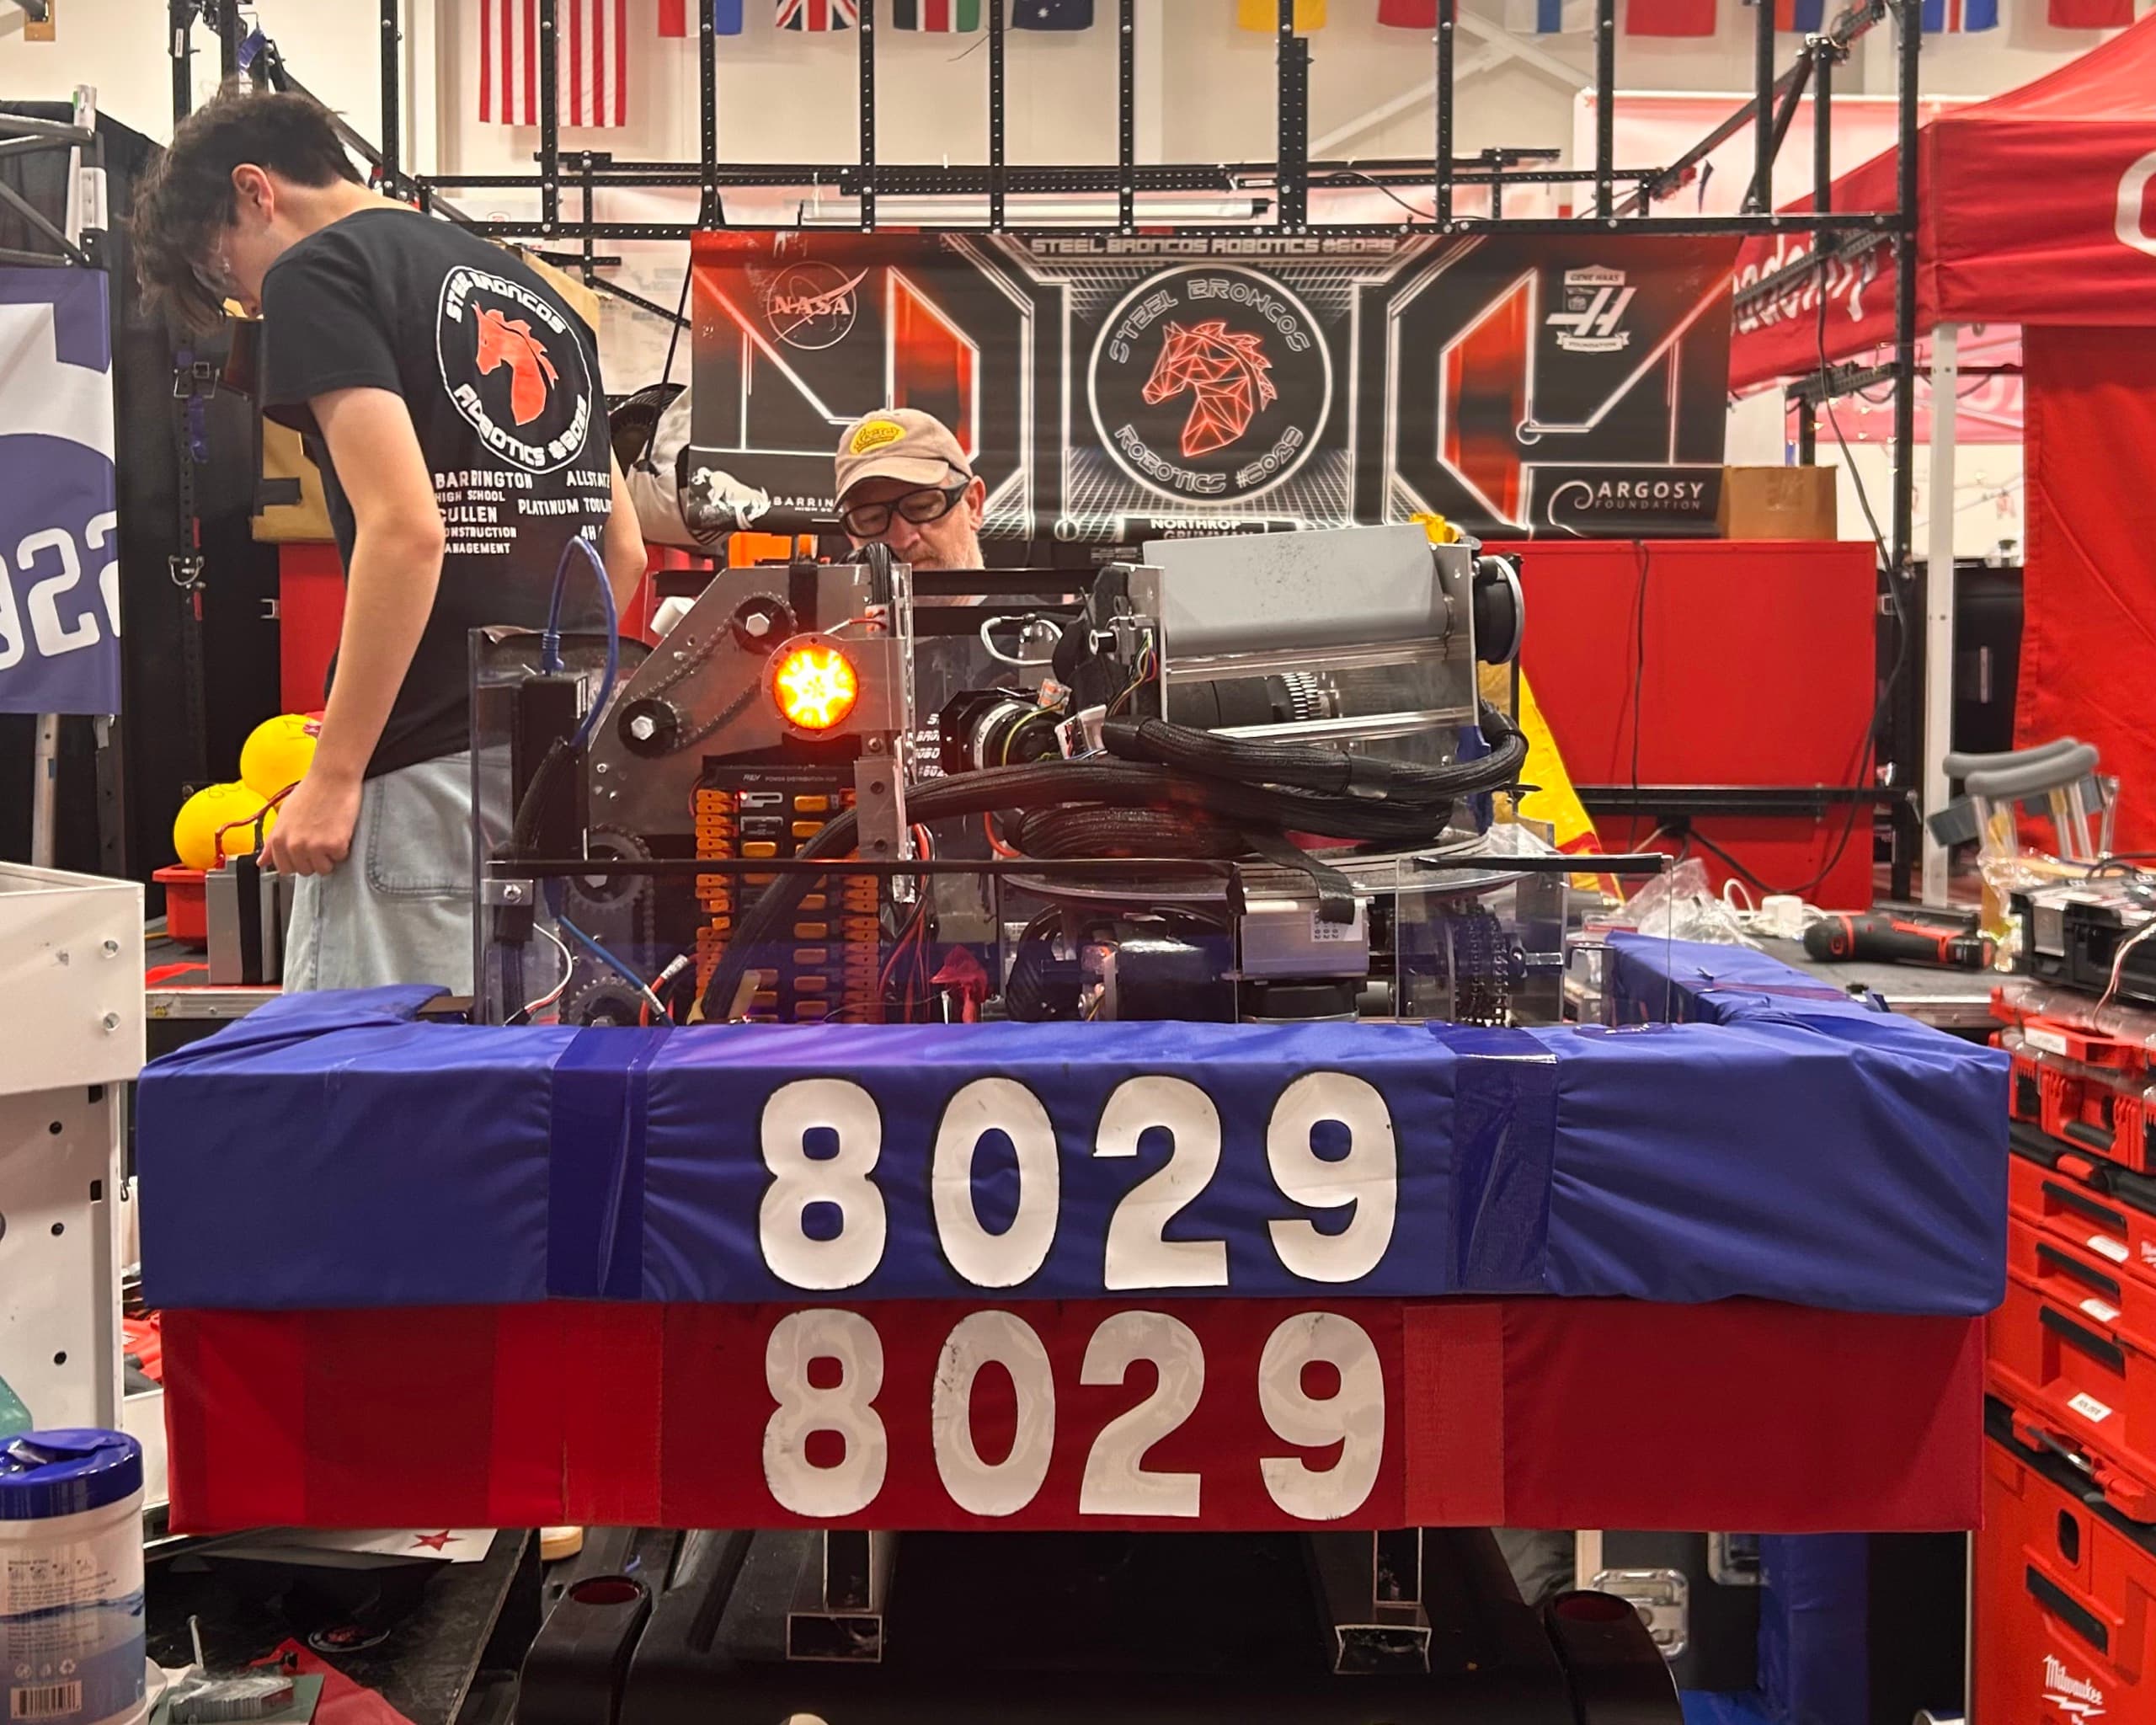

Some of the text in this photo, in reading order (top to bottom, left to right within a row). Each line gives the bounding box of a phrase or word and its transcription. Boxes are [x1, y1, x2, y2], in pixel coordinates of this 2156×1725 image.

[1031, 238, 1106, 254] STEEL
[1107, 238, 1208, 254] BRONCOS
[1211, 238, 1319, 254] ROBOTICS
[772, 296, 851, 316] NASA
[1108, 278, 1310, 364] STEEL BRONCOS
[453, 383, 546, 467] ROBOTICS
[1114, 424, 1305, 494] ROBOTICS #8029
[434, 469, 533, 489] BARRINGTON
[467, 489, 506, 503] SCHOOL
[1597, 481, 1705, 499] ARGOSY
[517, 498, 579, 516] PLATINUM
[774, 495, 835, 508] BARRIN
[1594, 499, 1700, 510] FOUNDATION
[446, 526, 517, 538] ONSTRUCTION
[1150, 518, 1242, 531] NORTHROP
[444, 542, 511, 554] ANAGEMENT
[758, 1070, 1398, 1291] 8029
[761, 1307, 1385, 1520] 8029
[2041, 1653, 2103, 1706] Milwaukee
